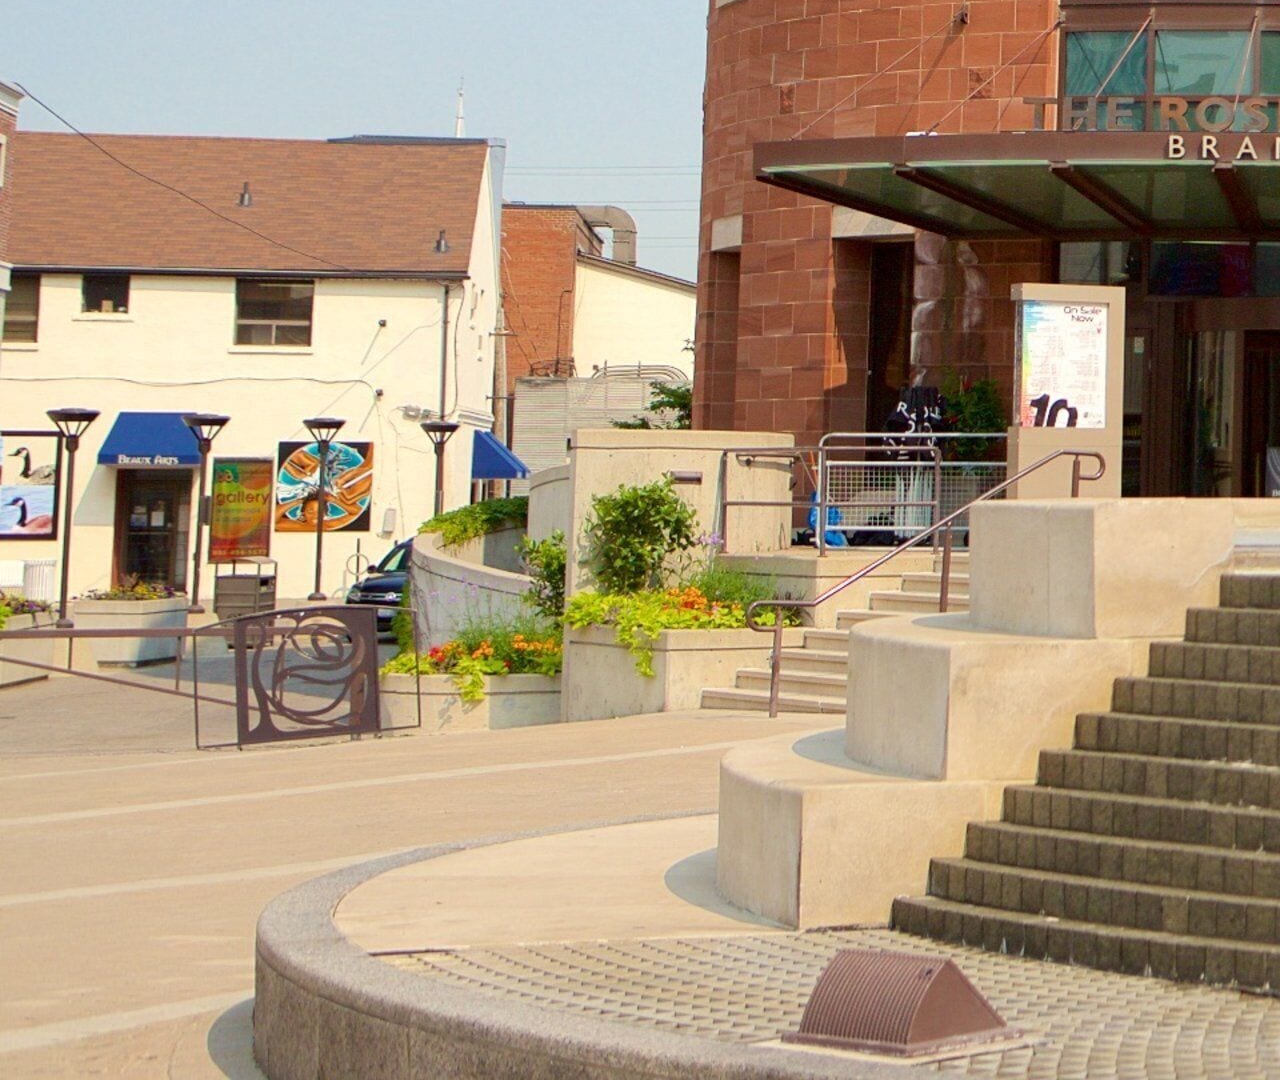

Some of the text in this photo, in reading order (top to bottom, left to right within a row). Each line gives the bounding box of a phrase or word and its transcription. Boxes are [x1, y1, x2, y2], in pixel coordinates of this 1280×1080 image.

[1022, 96, 1136, 131] THE
[1063, 306, 1078, 314] On
[216, 491, 270, 506] gallery
